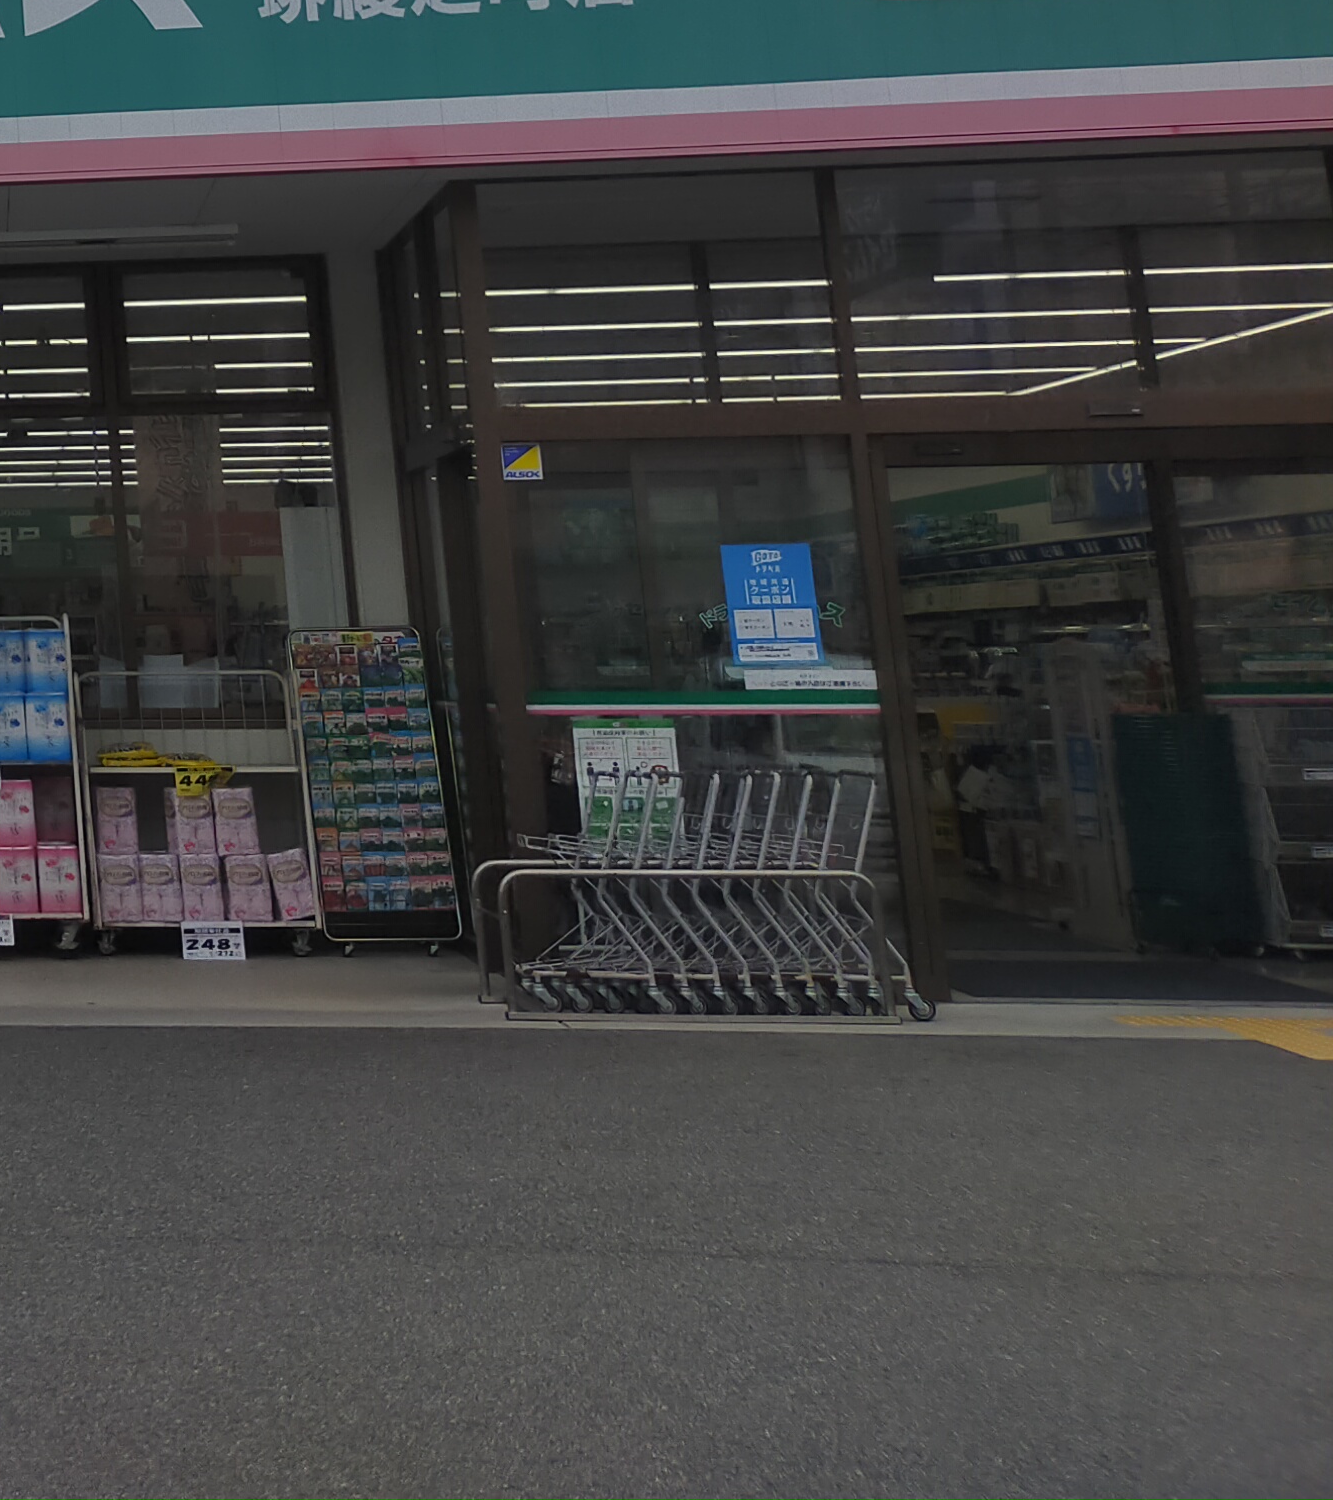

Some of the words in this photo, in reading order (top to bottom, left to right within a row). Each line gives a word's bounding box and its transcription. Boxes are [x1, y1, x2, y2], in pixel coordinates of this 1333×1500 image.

[505, 471, 540, 479] ALSOK
[749, 586, 791, 595] クーポン
[186, 938, 231, 951] 248
